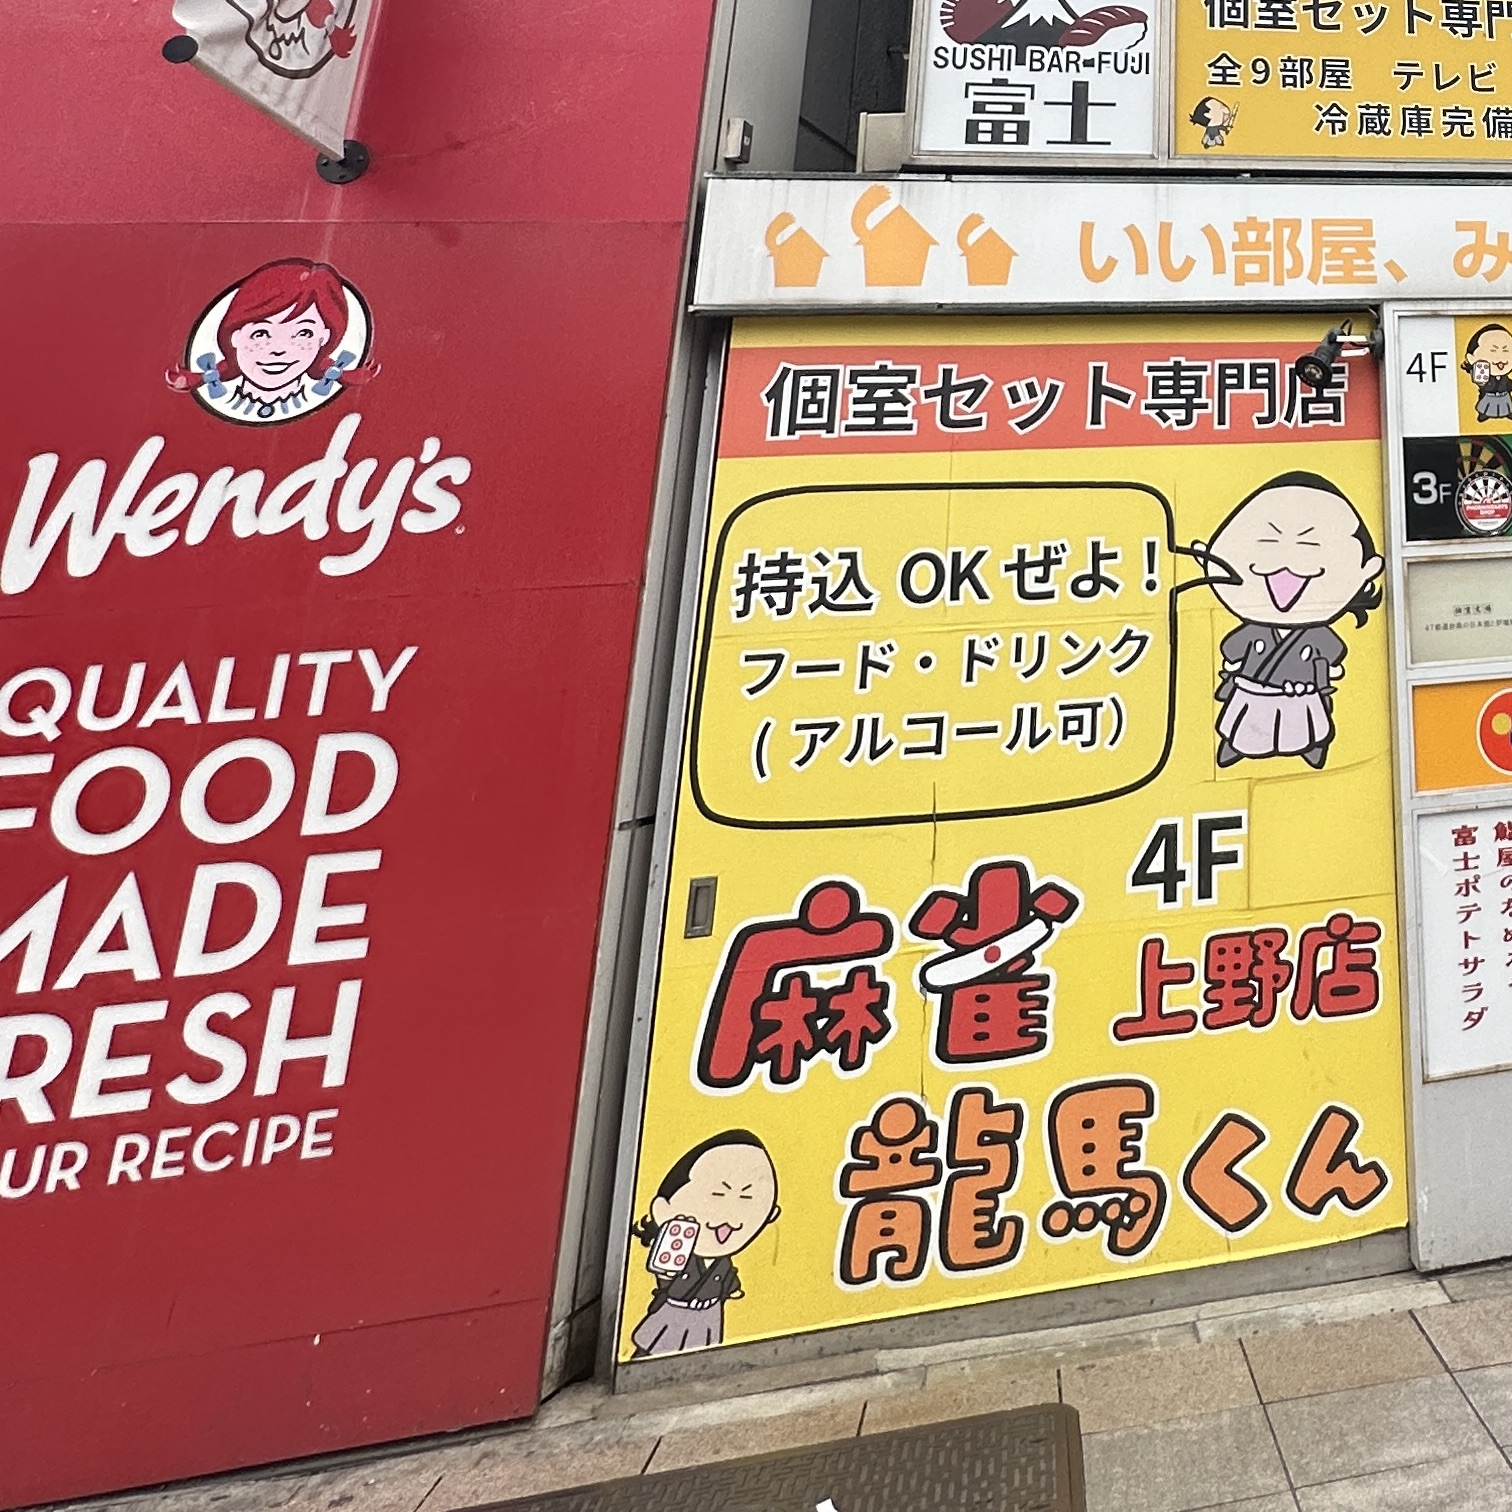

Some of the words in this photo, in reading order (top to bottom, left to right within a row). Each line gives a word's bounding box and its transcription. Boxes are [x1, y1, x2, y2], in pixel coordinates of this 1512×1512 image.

[933, 44, 1013, 73] SUSHI
[1028, 49, 1080, 75] BAR
[1098, 50, 1151, 76] FUJI
[1392, 59, 1499, 96] テレビ
[964, 78, 1117, 147] 富士
[765, 358, 1346, 438] 個室セット専門店
[1404, 351, 1449, 384] 4F
[0, 413, 472, 595] Wendy's
[1411, 471, 1452, 506] 3F
[732, 550, 875, 620] 持込
[899, 550, 991, 604] OK
[0, 646, 419, 742] QUALITY
[740, 626, 1152, 698] フード・ドリンク
[1131, 814, 1247, 907] 4F
[1451, 824, 1489, 1031] 富士ポテトサラダ
[693, 858, 1082, 1090] 麻雀
[1110, 912, 1385, 1044] 上野店
[107, 1108, 338, 1186] RECIPE
[836, 1076, 1392, 1288] 龍馬くん
